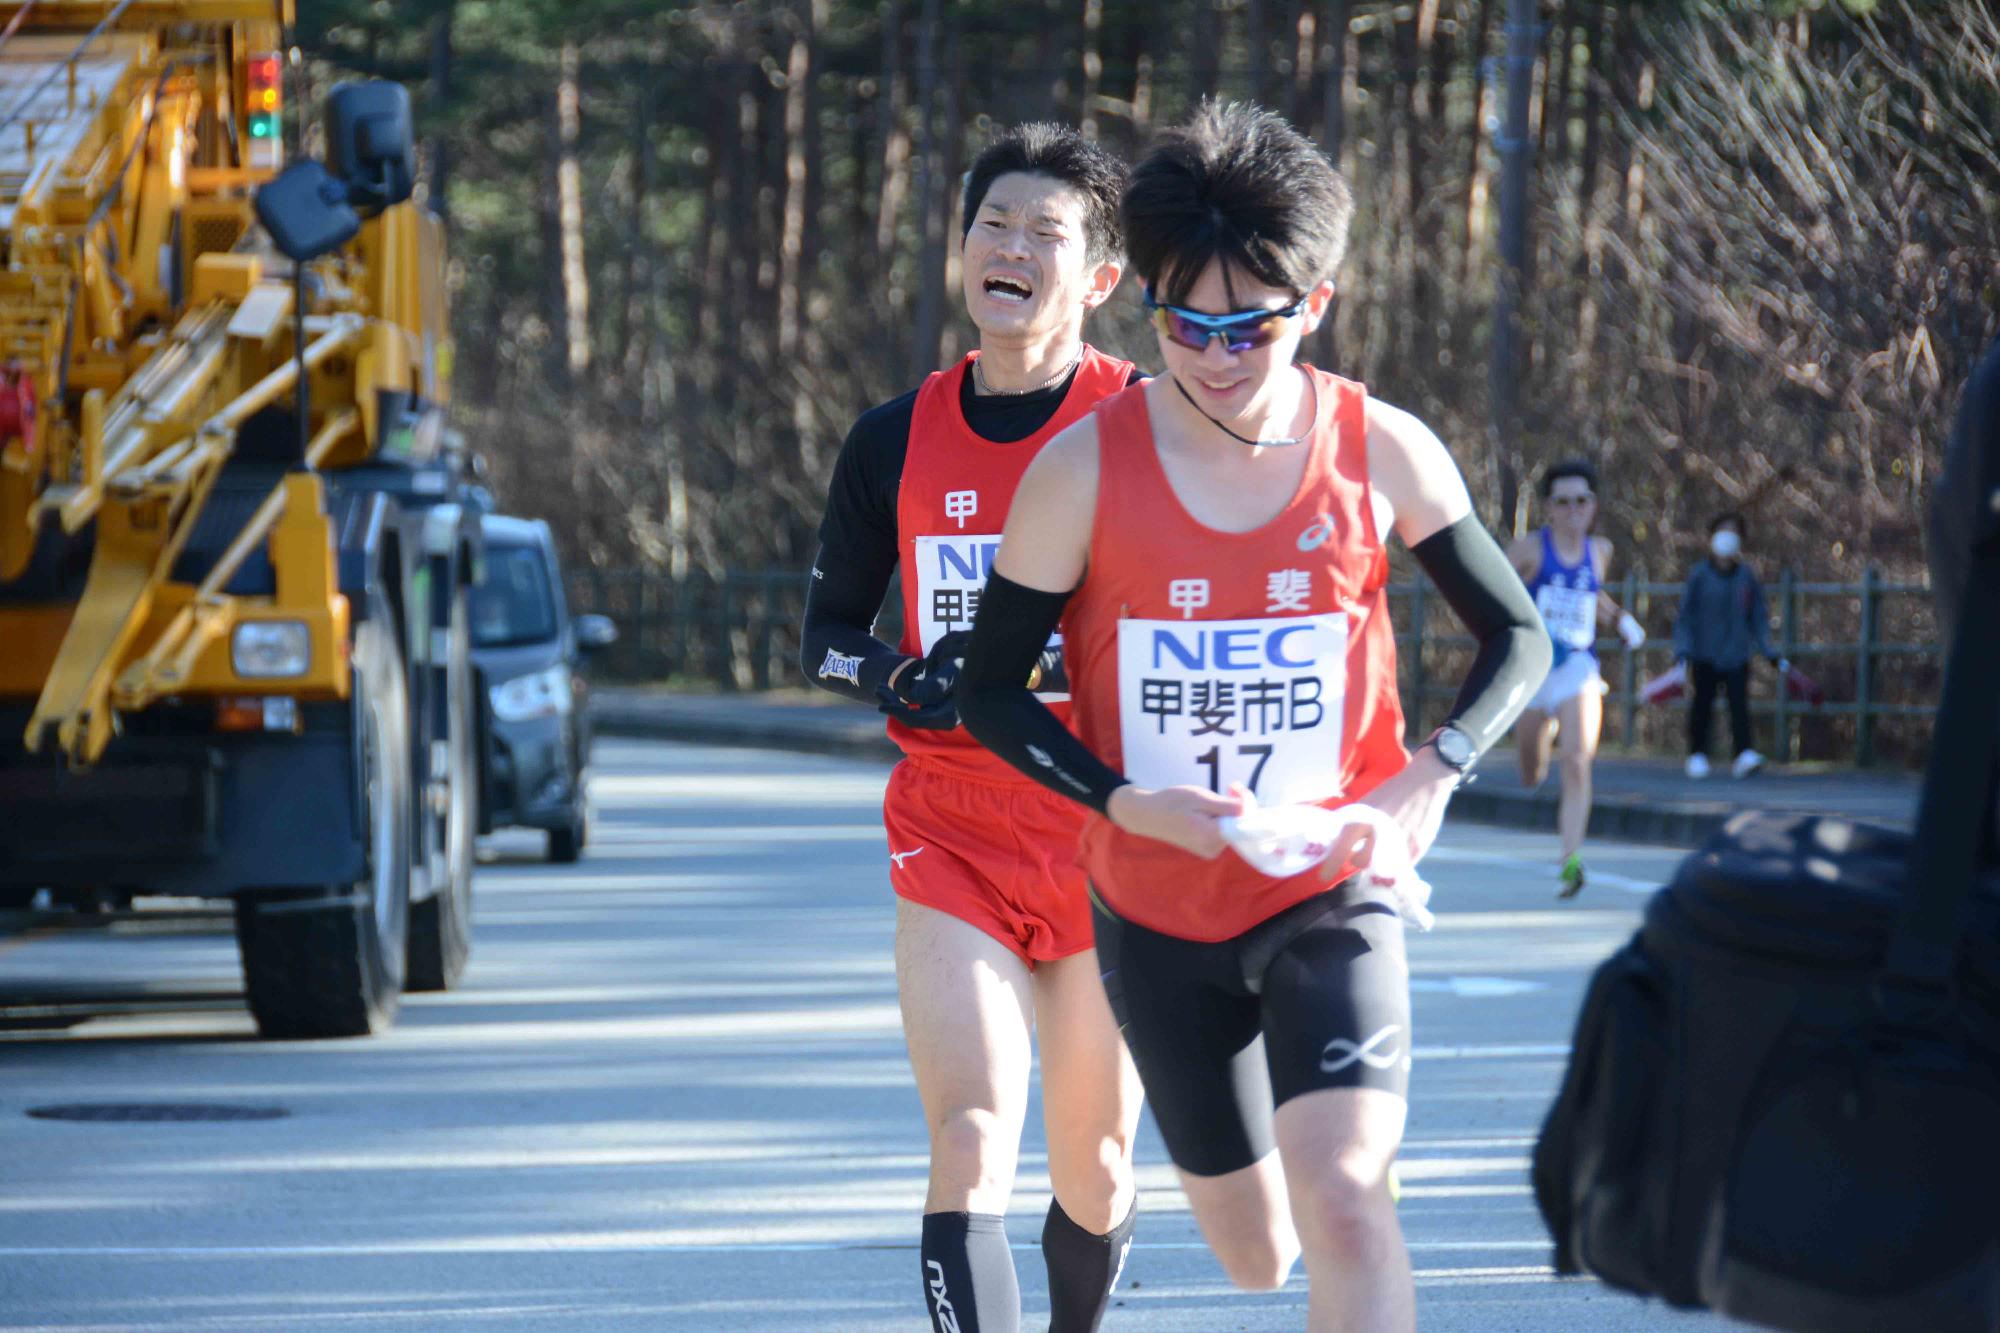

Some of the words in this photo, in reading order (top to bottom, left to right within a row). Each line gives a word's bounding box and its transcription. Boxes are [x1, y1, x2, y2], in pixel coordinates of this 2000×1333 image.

[945, 490, 977, 529] 甲
[819, 652, 860, 680] JAPAN
[1152, 625, 1316, 670] NEC
[1140, 676, 1324, 737] 甲斐市B
[1195, 744, 1273, 797] 17
